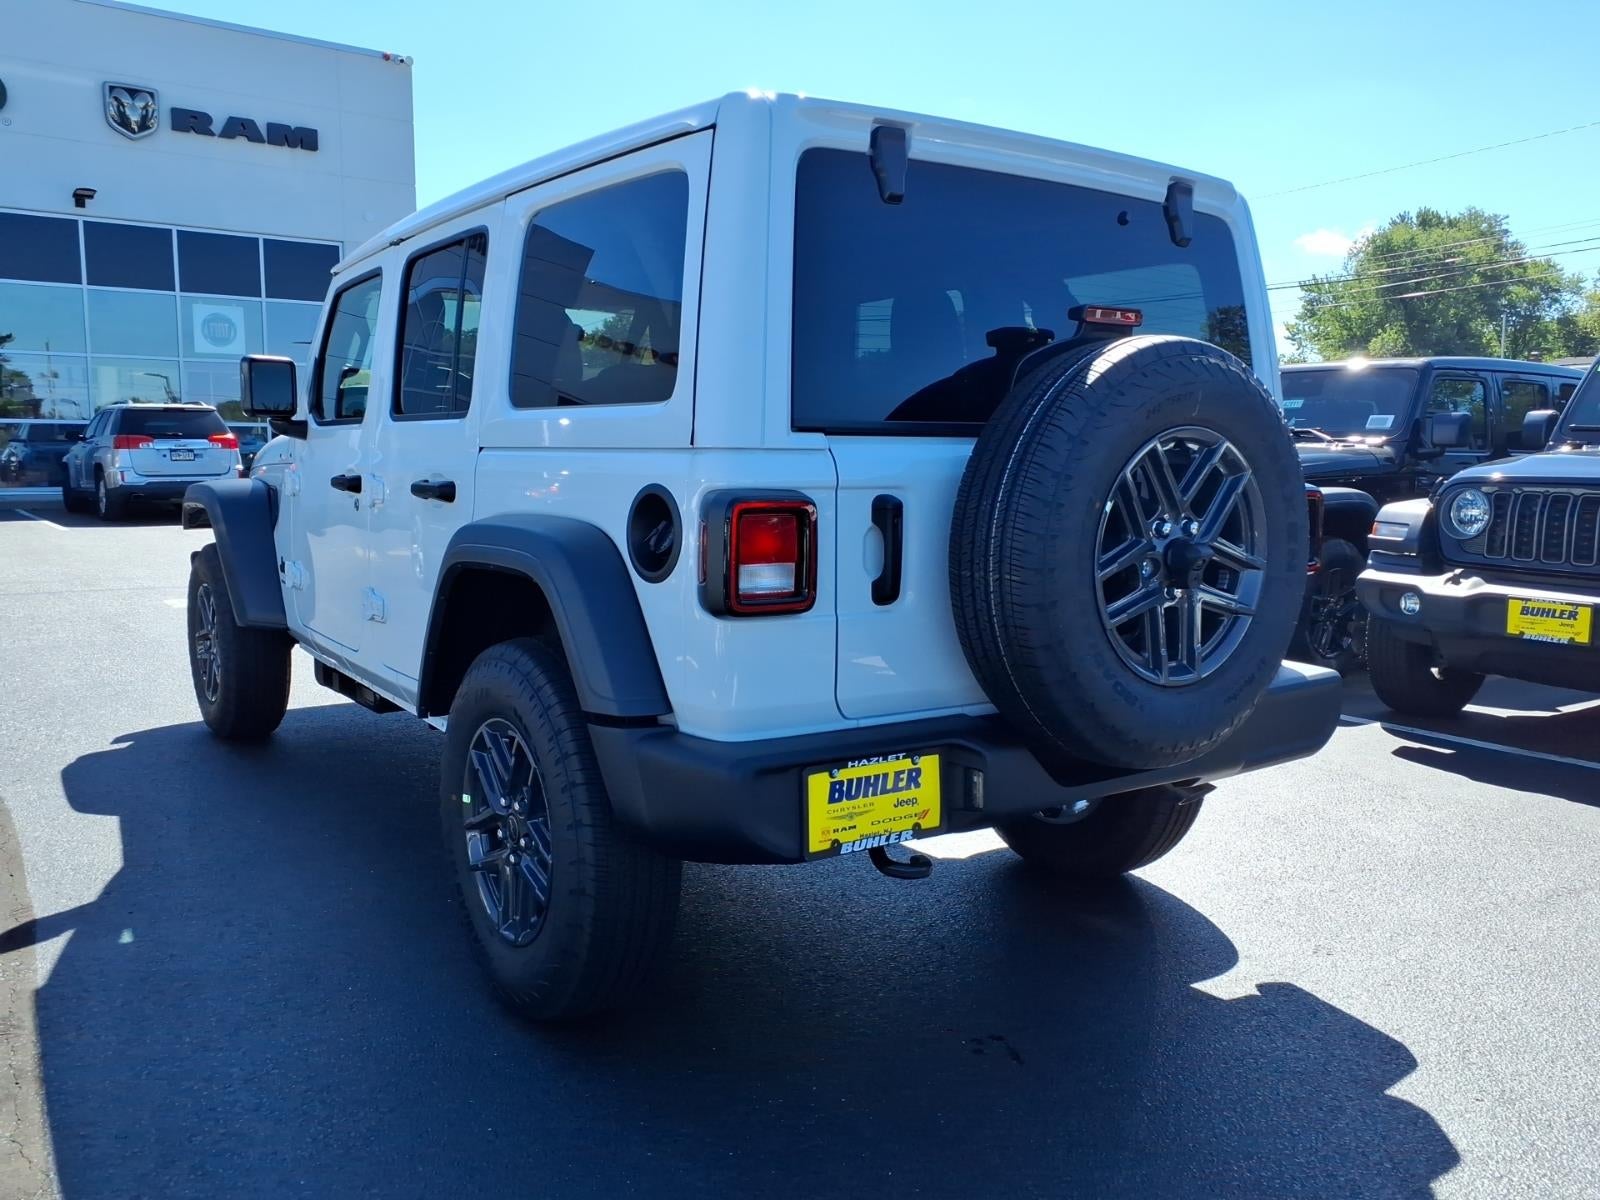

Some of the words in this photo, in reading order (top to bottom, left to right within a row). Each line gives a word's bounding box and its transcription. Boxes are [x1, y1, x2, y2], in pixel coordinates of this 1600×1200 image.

[170, 107, 319, 151] RAM
[1520, 605, 1579, 621] BUHLER
[848, 753, 906, 768] HAZLET
[828, 767, 922, 804] BUHLER
[827, 803, 875, 814] CHRYSLER
[893, 796, 919, 809] Jeep
[871, 812, 923, 826] DODGE
[832, 825, 857, 834] RAM
[841, 830, 913, 854] BUHLER
